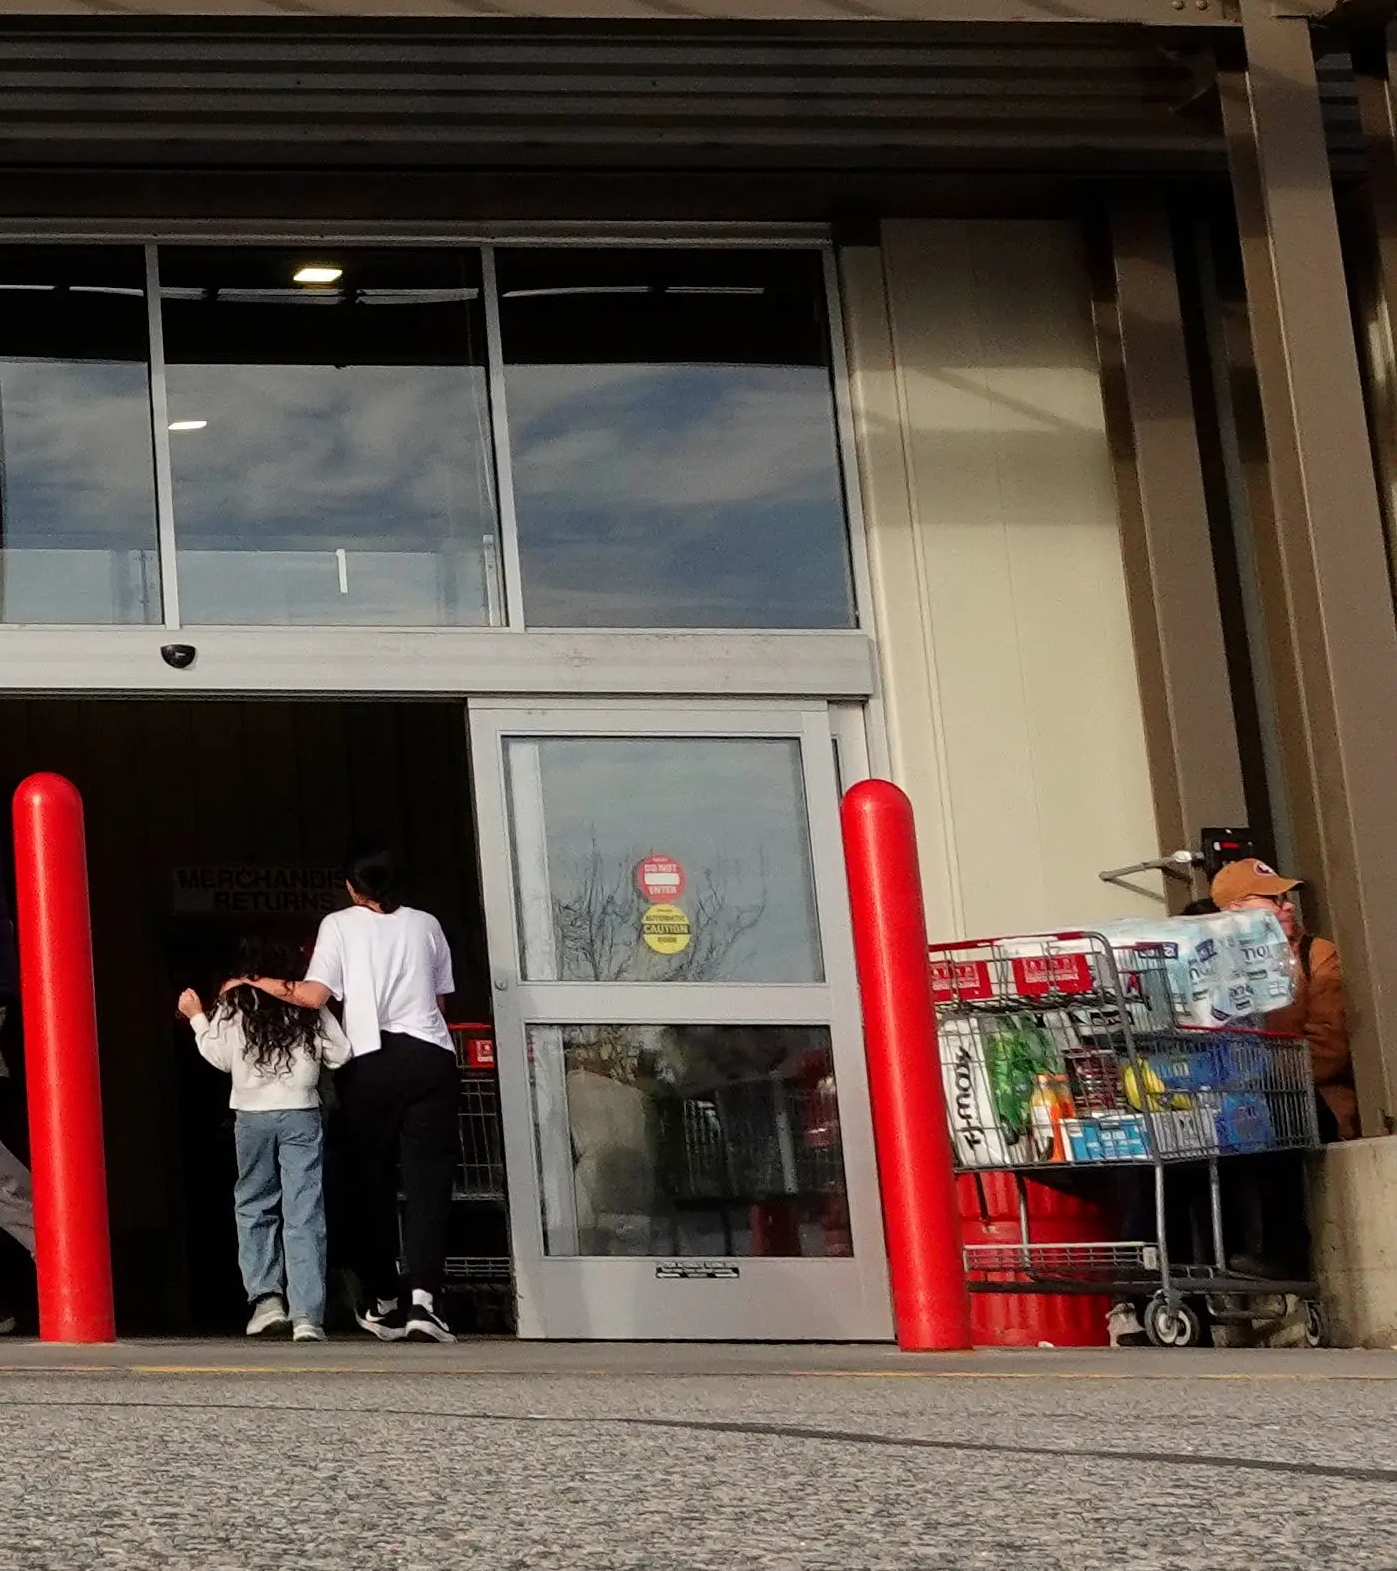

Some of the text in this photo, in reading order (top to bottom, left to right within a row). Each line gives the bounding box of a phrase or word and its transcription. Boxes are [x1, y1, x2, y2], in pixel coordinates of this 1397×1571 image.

[177, 867, 345, 890] MERCHANDIS
[214, 891, 336, 911] RETURNS
[644, 924, 689, 934] CAUTION
